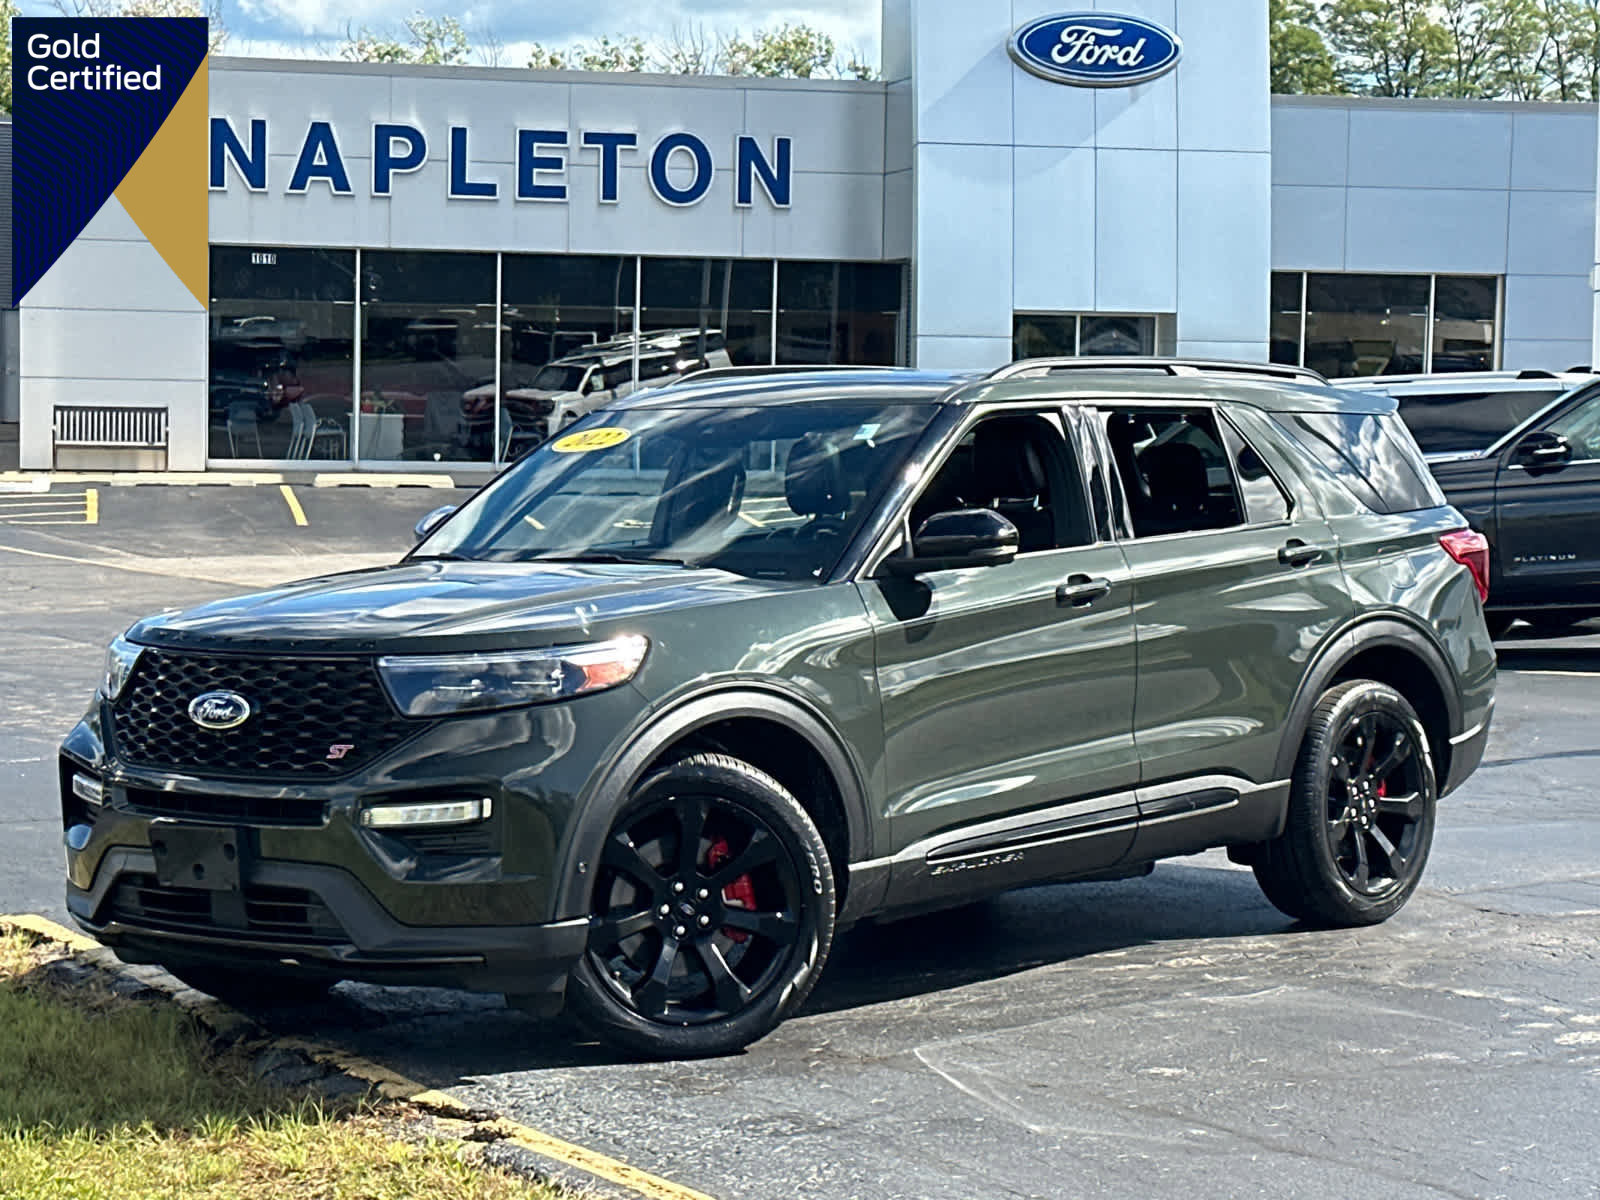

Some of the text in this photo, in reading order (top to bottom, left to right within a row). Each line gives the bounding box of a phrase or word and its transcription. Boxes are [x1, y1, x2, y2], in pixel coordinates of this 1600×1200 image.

[1051, 25, 1147, 67] Ford
[209, 117, 793, 209] NAPLETON
[1513, 553, 1576, 562] PLATINUM
[326, 744, 355, 760] ST
